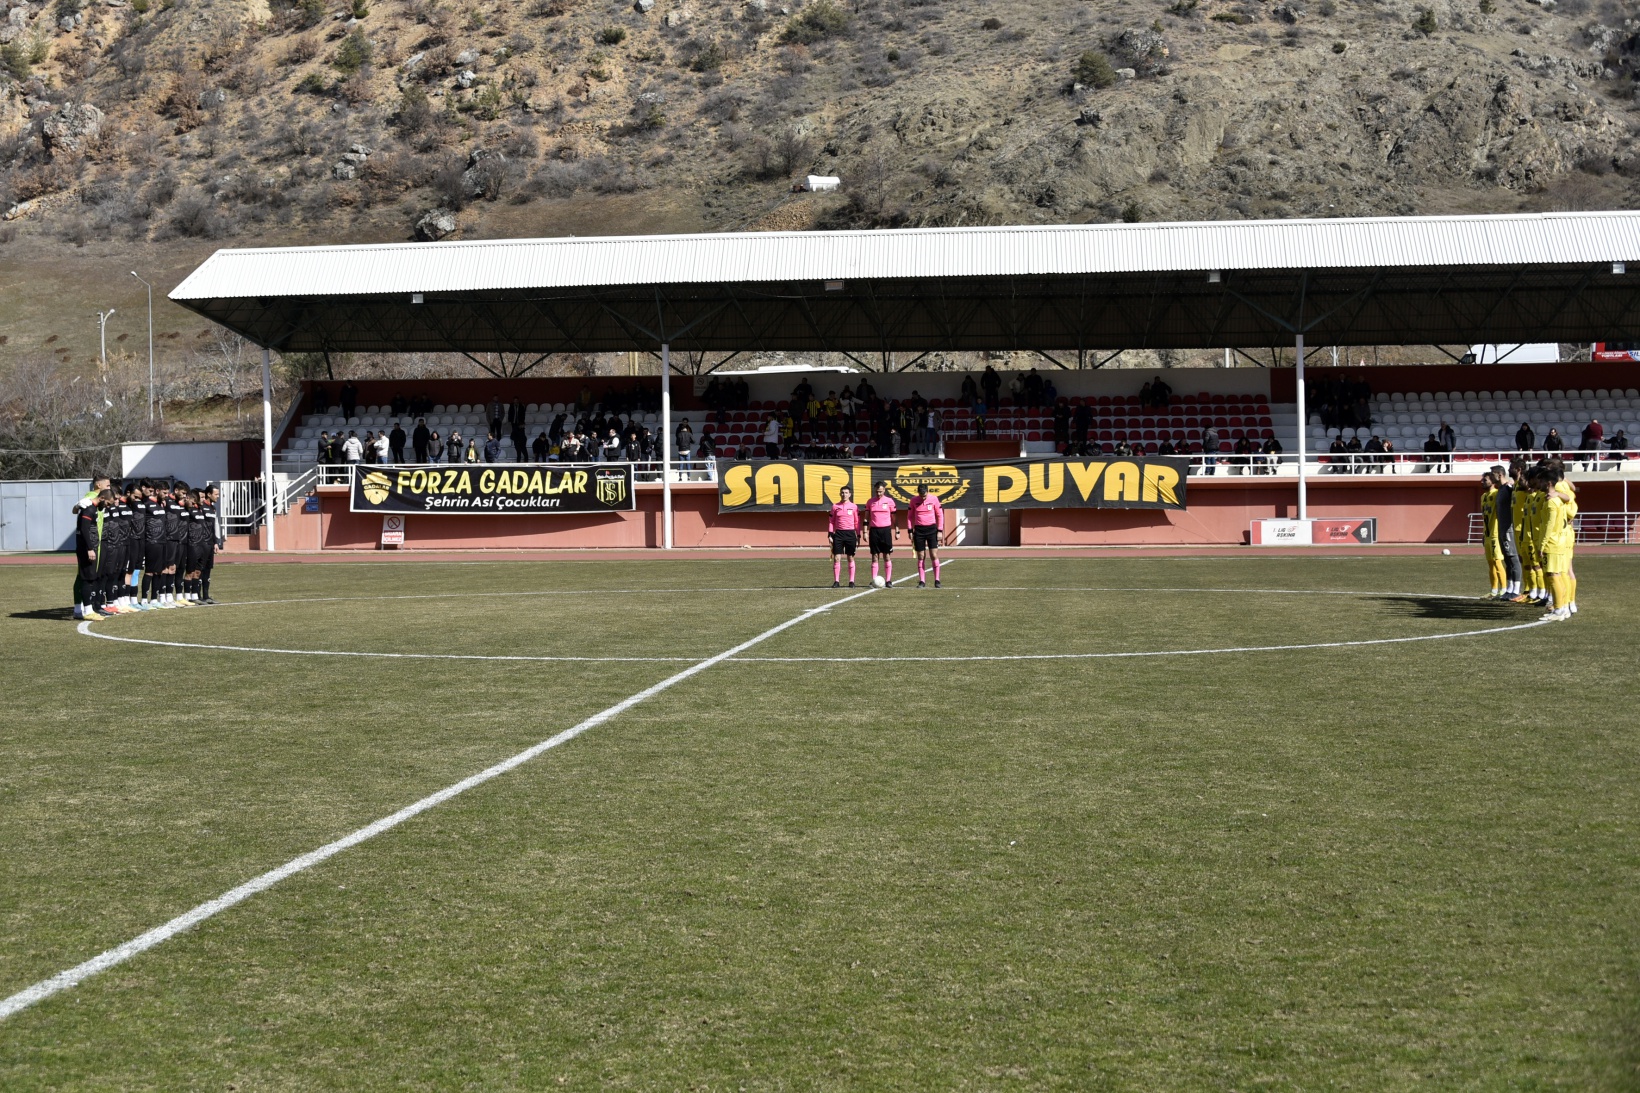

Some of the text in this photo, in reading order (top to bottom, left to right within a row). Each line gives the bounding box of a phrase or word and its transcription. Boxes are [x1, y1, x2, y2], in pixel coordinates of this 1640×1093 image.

[396, 469, 588, 494] FORZA GADALAR
[722, 463, 871, 506] SARI
[983, 461, 1179, 504] DUVAR
[424, 496, 560, 510] Şehrin Asi Çocukları
